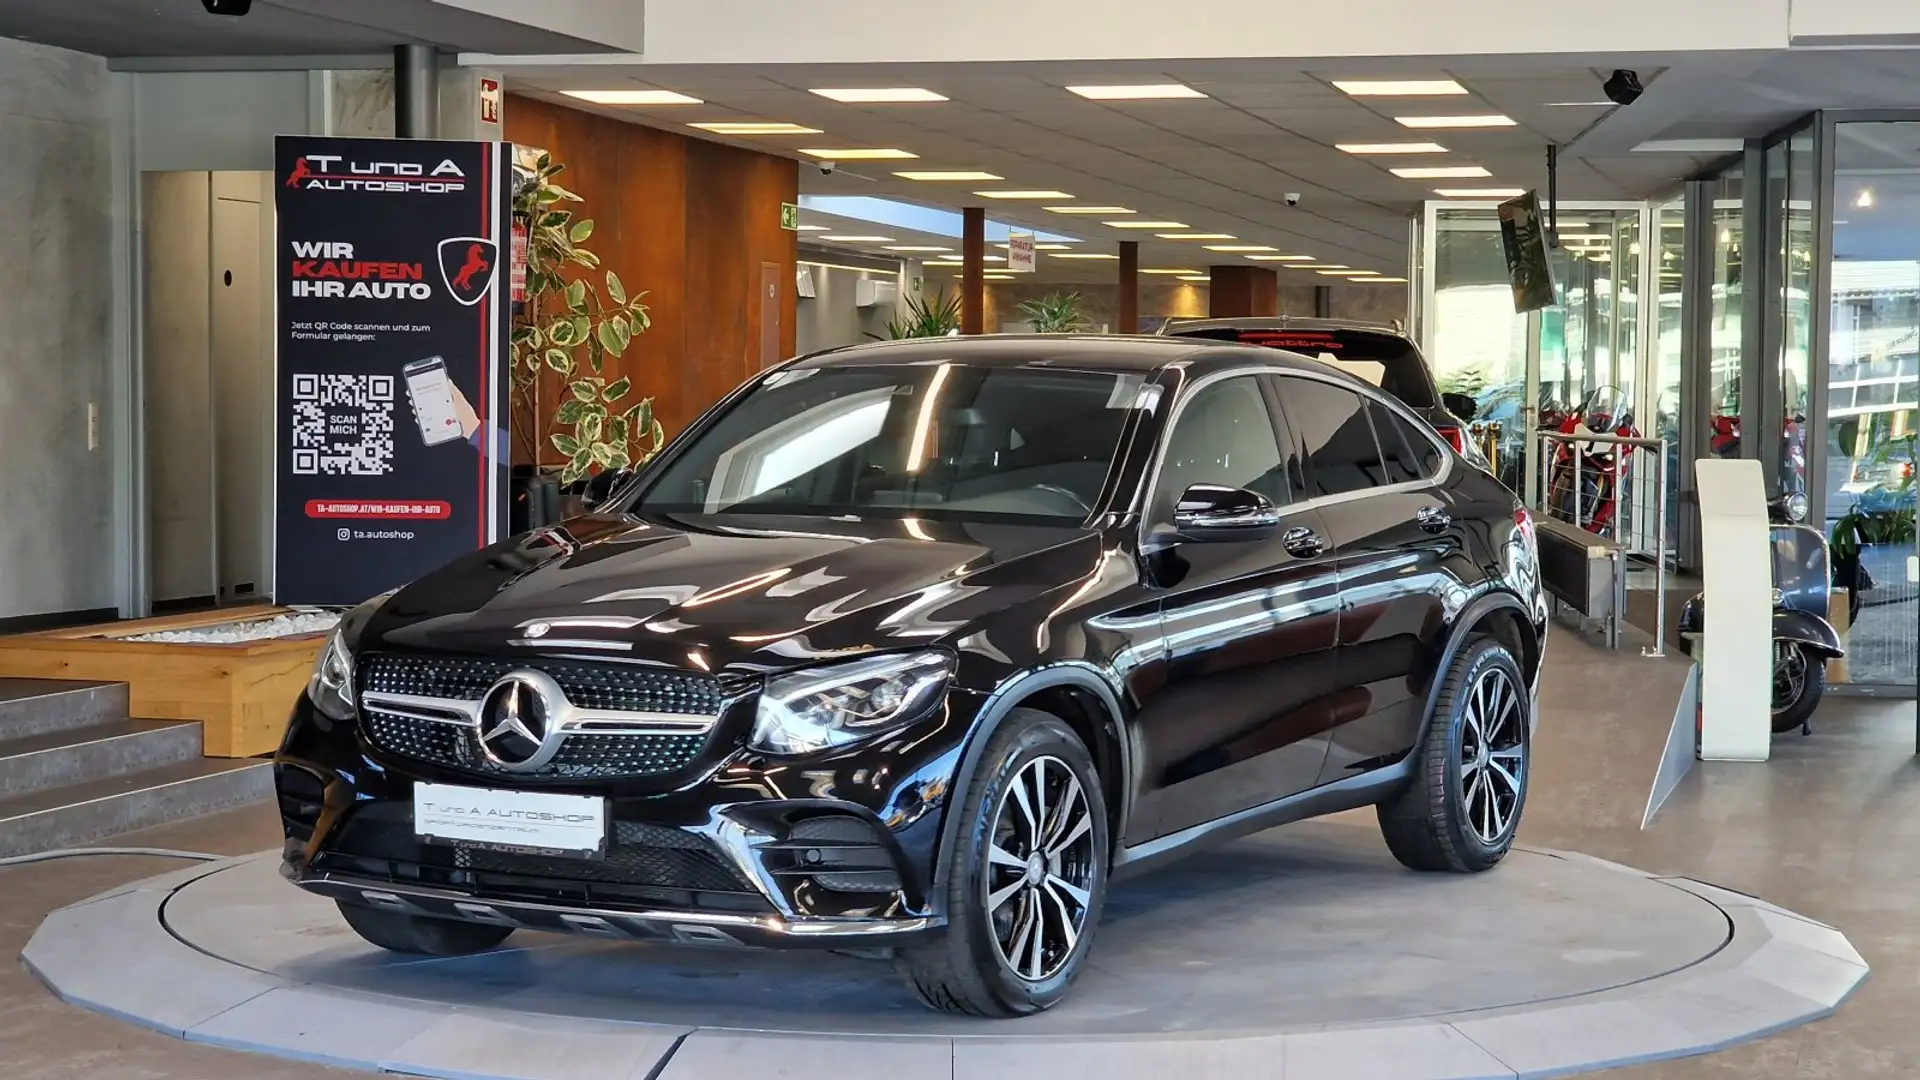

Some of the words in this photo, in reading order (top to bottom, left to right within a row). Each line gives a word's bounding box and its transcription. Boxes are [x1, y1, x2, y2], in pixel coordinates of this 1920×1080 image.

[306, 155, 342, 172] T
[430, 159, 464, 177] A
[306, 179, 465, 193] AUTOSHOP
[291, 241, 354, 259] WIR
[292, 261, 423, 280] KAUFEN
[292, 281, 345, 298] IHR
[348, 282, 431, 300] AUTO
[291, 321, 313, 330] Jetzt
[314, 321, 328, 331] QR
[330, 322, 353, 330] Code
[353, 323, 390, 331] scannen
[392, 323, 410, 332] und
[291, 331, 331, 340] Formular
[333, 332, 376, 342] gelangen:
[329, 415, 357, 424] SCAN
[329, 425, 357, 435] MICH
[353, 530, 414, 540] ta.autoshop
[423, 802, 434, 812] T
[470, 807, 481, 816] A
[487, 808, 595, 823] AUTOSHOP
[451, 839, 460, 847] T
[477, 842, 486, 850] A
[492, 844, 564, 856] AUTOSHOP
